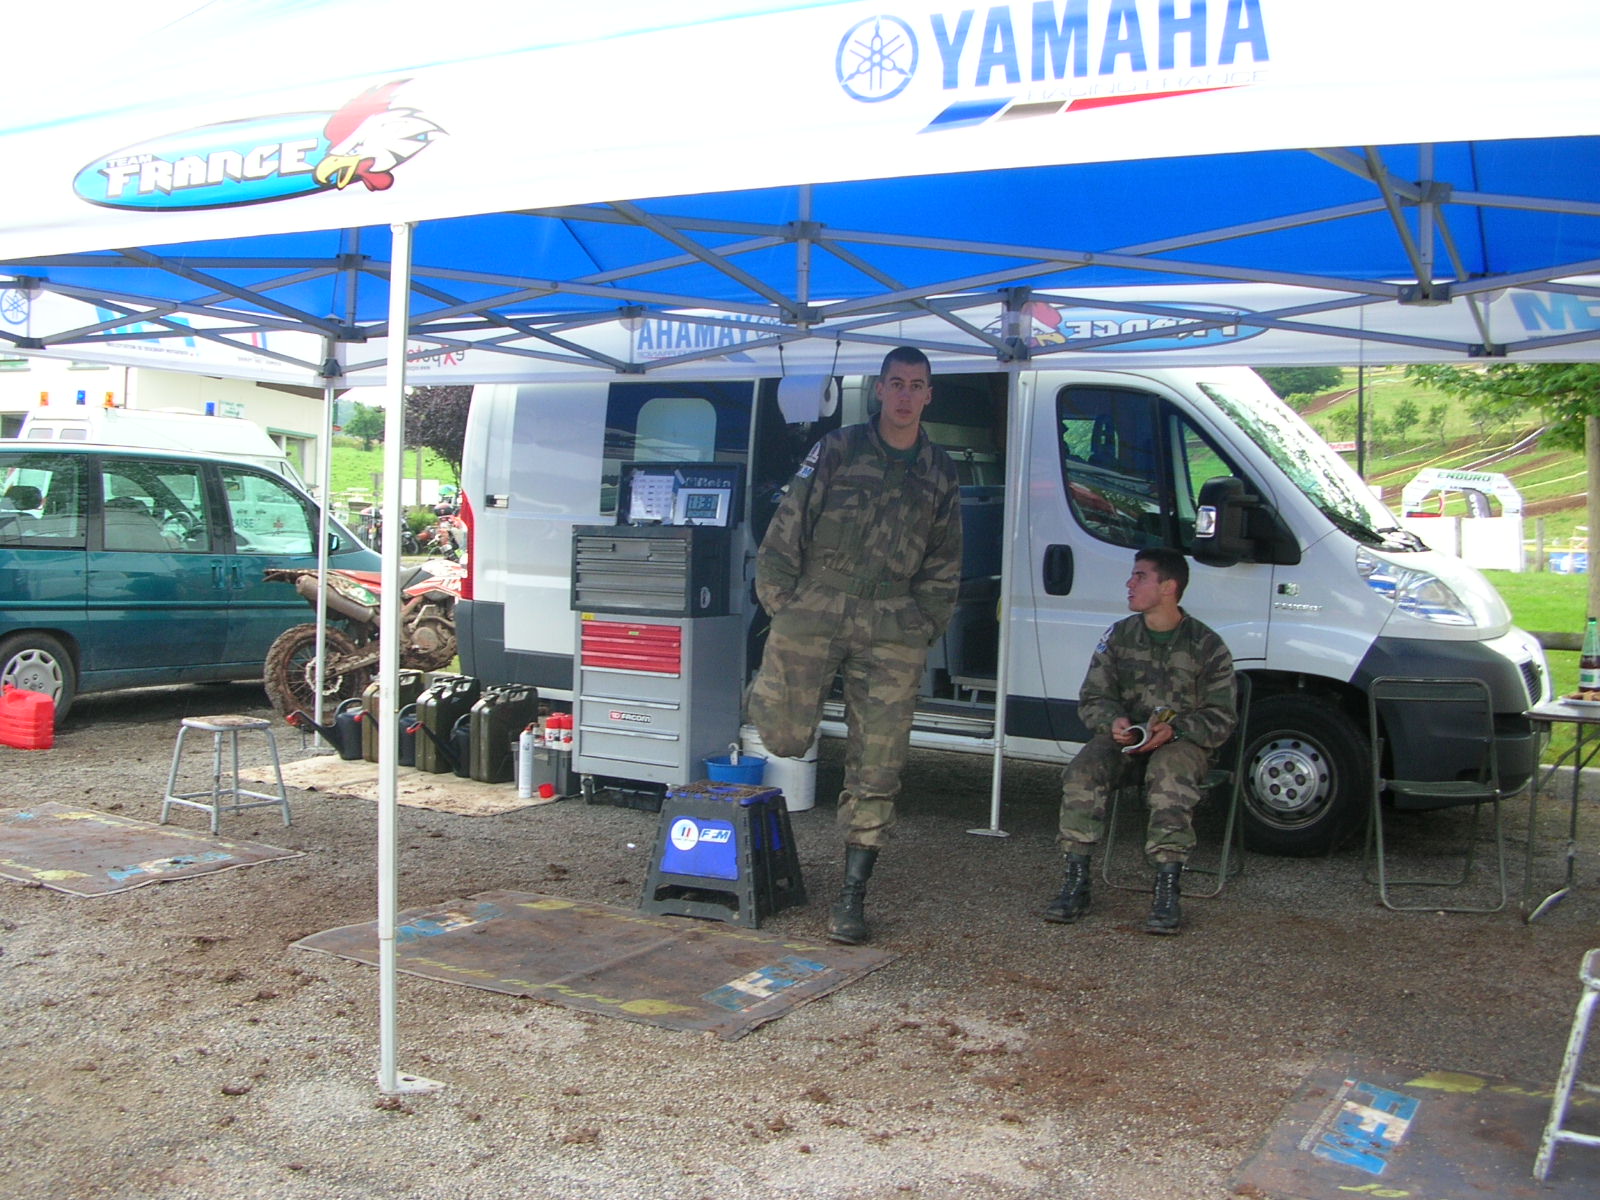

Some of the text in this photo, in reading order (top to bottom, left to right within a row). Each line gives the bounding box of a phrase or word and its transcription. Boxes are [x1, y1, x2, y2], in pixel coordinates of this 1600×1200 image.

[930, 0, 1270, 90] YAMAHA
[98, 138, 318, 198] FRANCE
[107, 153, 152, 167] TEAM
[621, 713, 650, 723] FACOM
